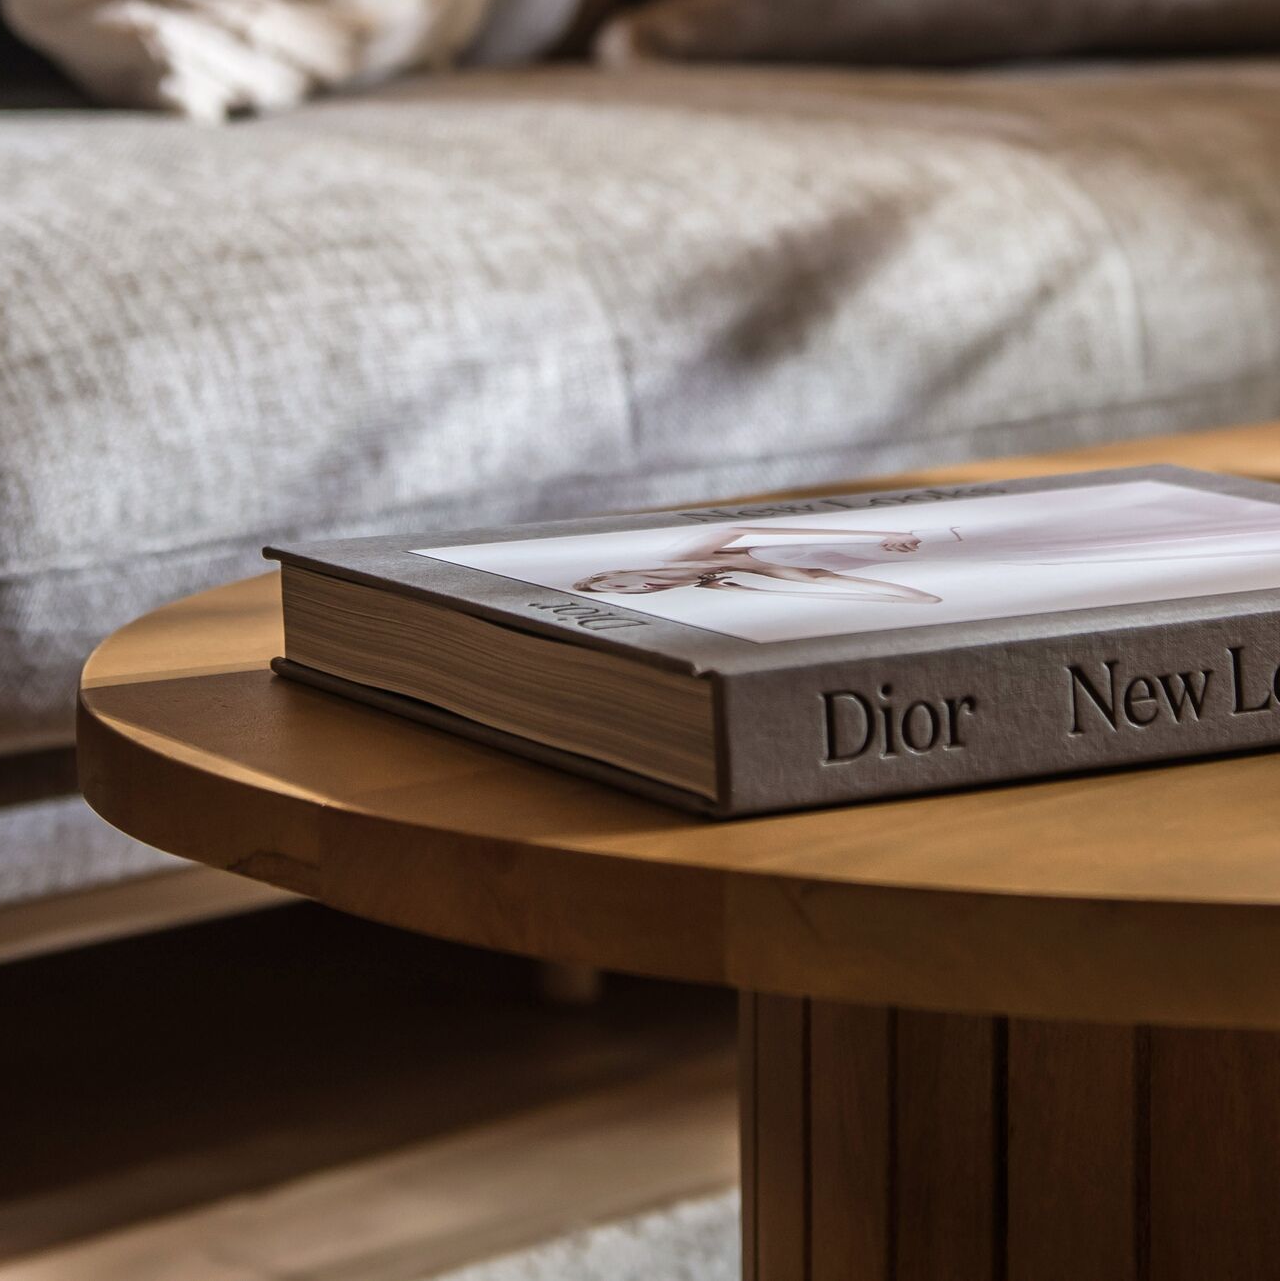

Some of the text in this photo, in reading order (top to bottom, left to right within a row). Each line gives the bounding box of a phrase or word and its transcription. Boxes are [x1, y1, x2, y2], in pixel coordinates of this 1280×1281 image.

[528, 601, 652, 631] Dior
[819, 683, 977, 767] Dior
[1065, 658, 1214, 738] New
